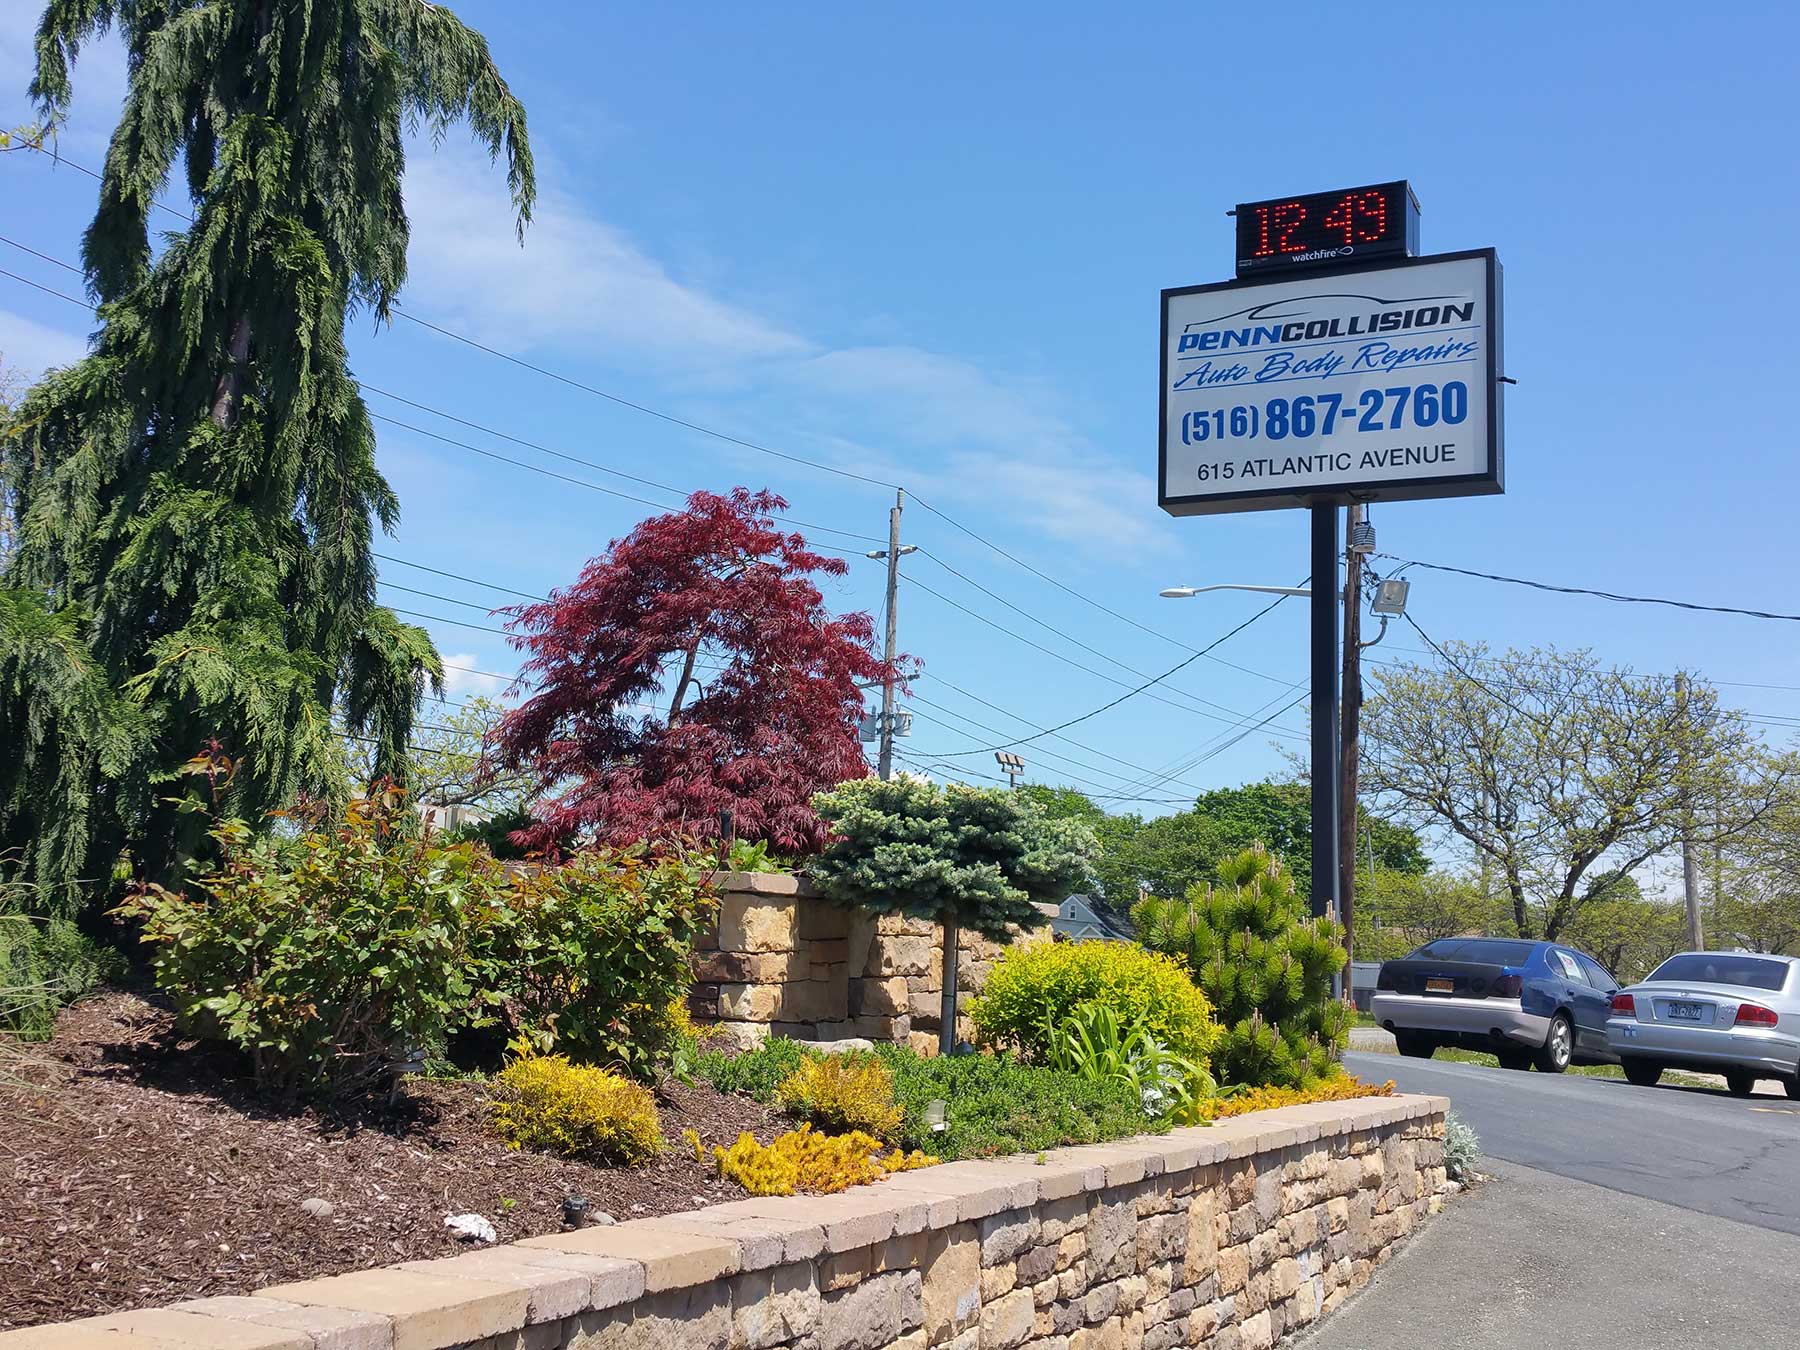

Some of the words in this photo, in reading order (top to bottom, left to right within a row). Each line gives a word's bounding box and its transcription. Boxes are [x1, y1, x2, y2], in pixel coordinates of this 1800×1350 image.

[1292, 249, 1337, 262] watchfire
[1173, 361, 1249, 388] Auto
[1254, 349, 1345, 383] Body
[1351, 336, 1479, 371] Repairs
[1181, 405, 1258, 446] (516)
[1265, 381, 1468, 440] 867-2760
[1198, 461, 1235, 481] 615
[1240, 453, 1352, 478] ATLANTIC
[1359, 443, 1456, 470] AVENUE
